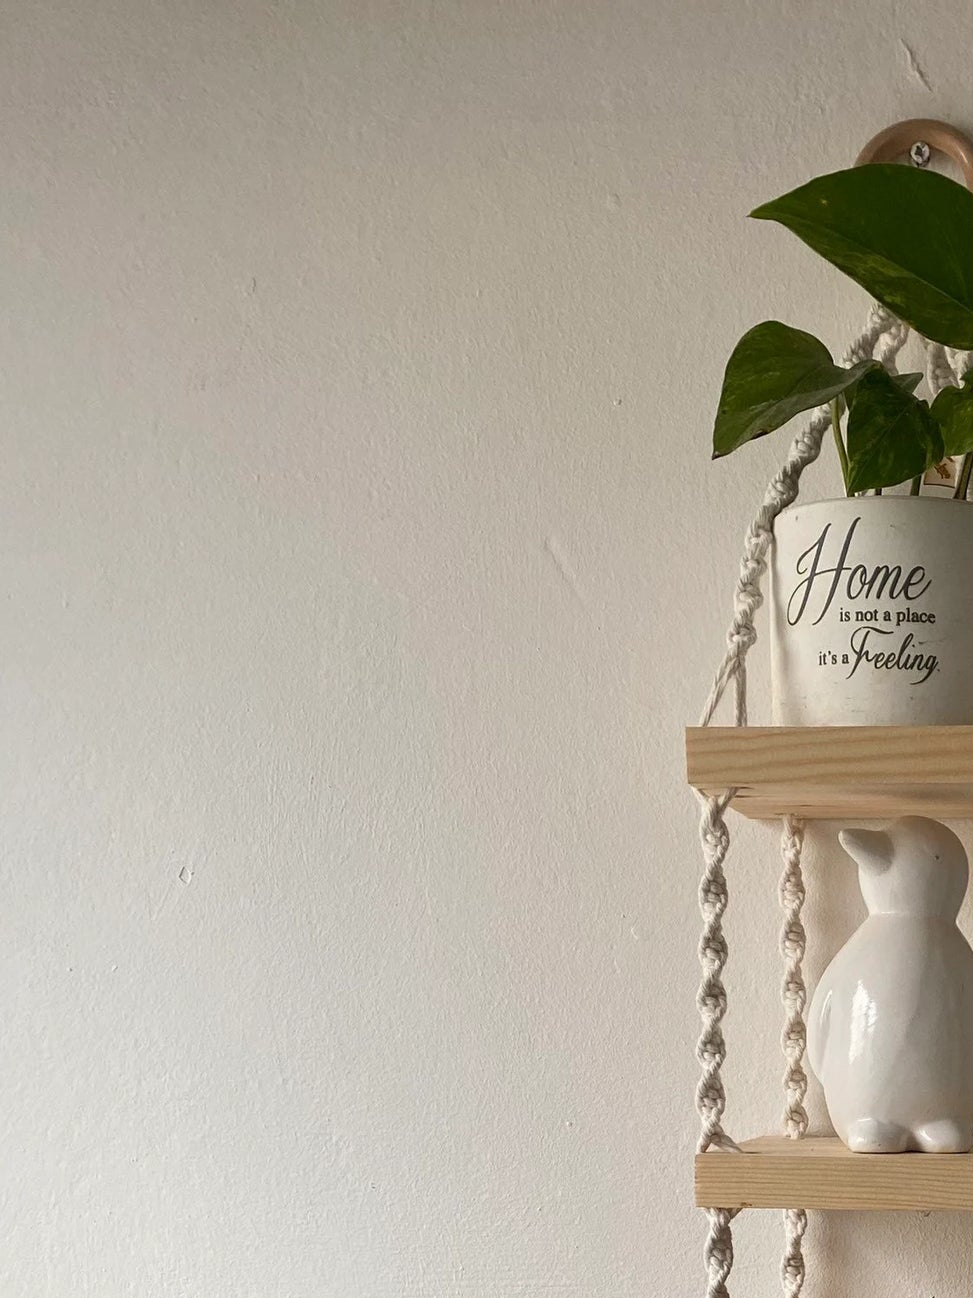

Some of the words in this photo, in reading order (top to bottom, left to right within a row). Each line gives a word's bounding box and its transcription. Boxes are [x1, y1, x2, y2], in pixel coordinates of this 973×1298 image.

[787, 516, 933, 627] Home
[839, 606, 851, 623] is
[855, 608, 879, 622] not
[883, 610, 892, 622] a
[895, 606, 936, 627] place
[818, 650, 838, 666] it's
[841, 653, 850, 665] a
